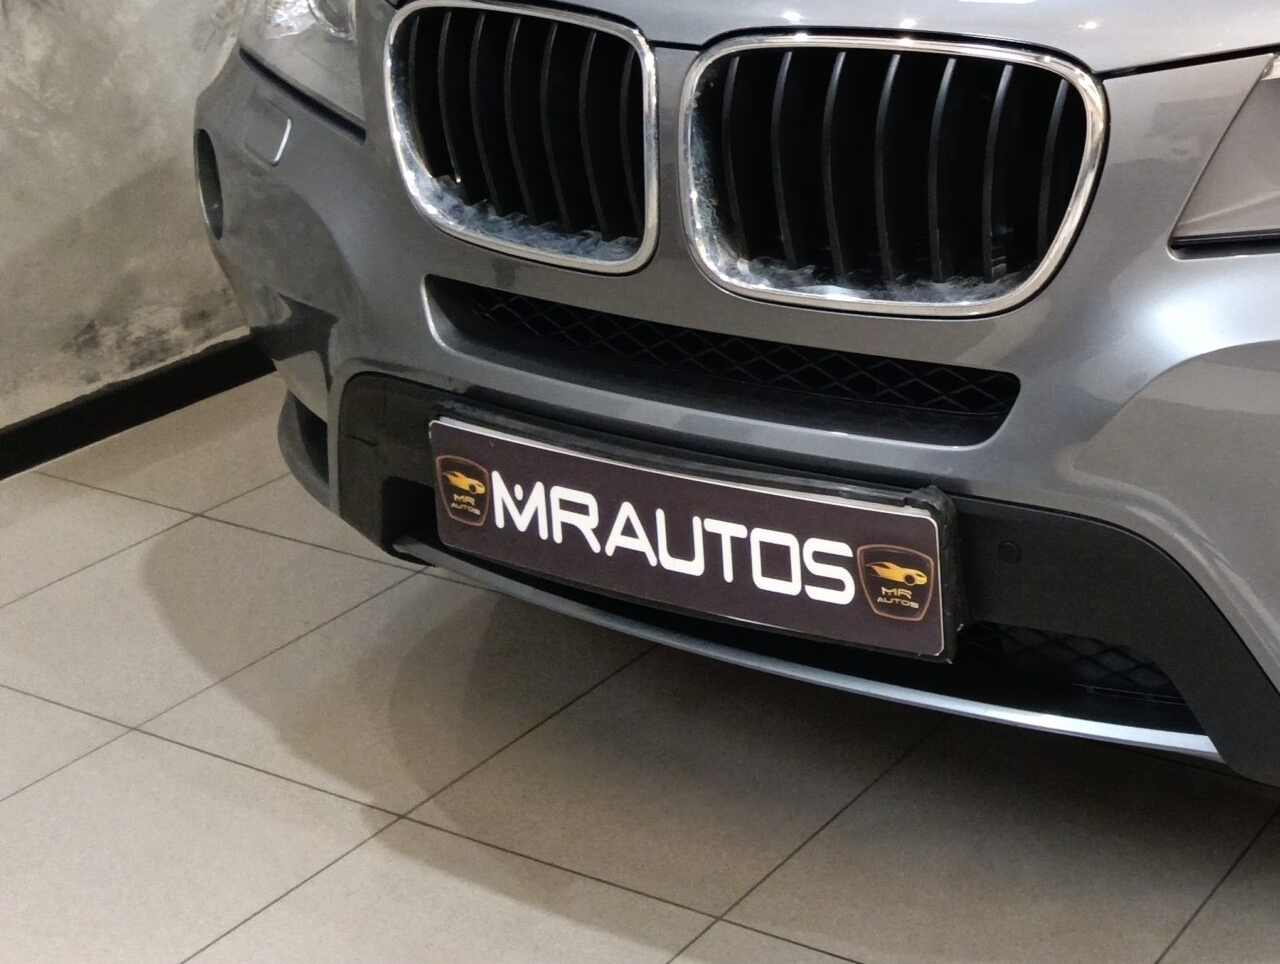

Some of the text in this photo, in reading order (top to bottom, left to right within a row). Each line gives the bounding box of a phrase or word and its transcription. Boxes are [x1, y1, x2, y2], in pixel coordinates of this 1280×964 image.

[491, 470, 855, 605] MRAUTOS
[881, 586, 912, 599] MR
[877, 596, 919, 609] AUTOS
